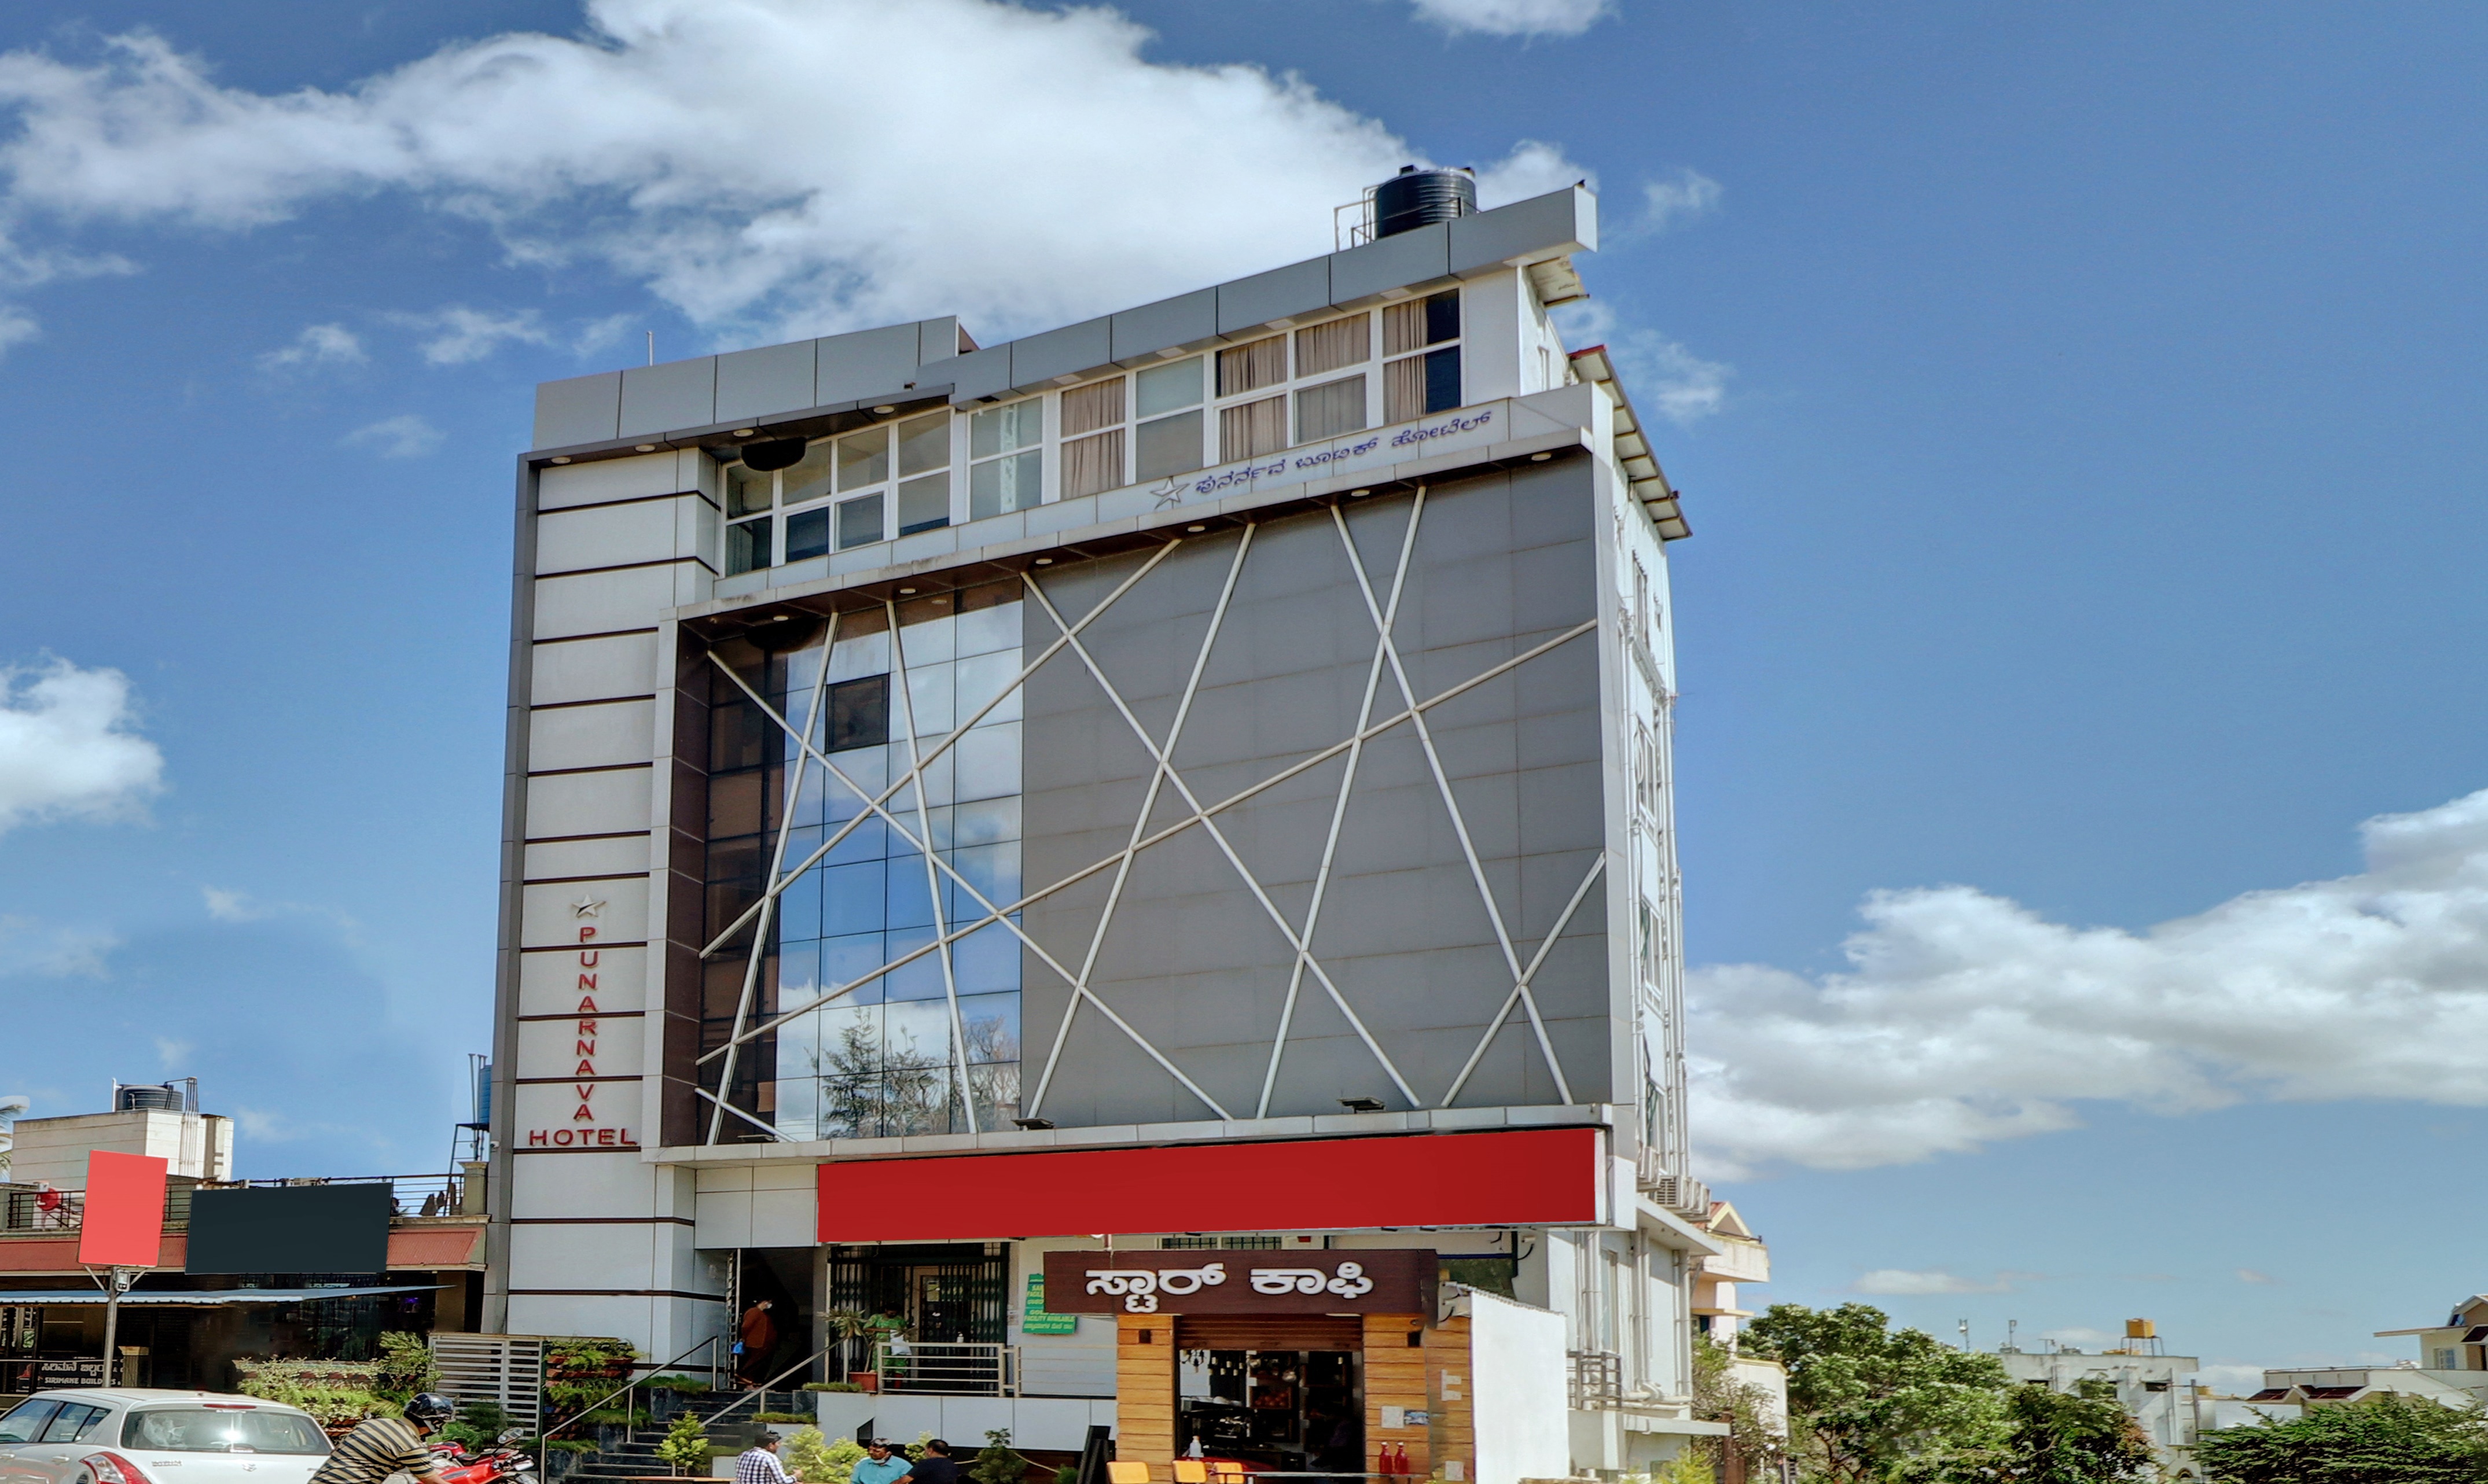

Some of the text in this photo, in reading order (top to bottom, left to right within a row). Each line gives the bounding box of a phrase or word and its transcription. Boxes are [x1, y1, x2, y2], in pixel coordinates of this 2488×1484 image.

[1391, 411, 1491, 447] ಹೋಟೆಲ್
[573, 926, 600, 1121] PUNARNAVA
[529, 1128, 638, 1147] HOTEL
[1085, 1261, 1374, 1313] ಸ್ಟಾರ್ ಕಾಫಿ
